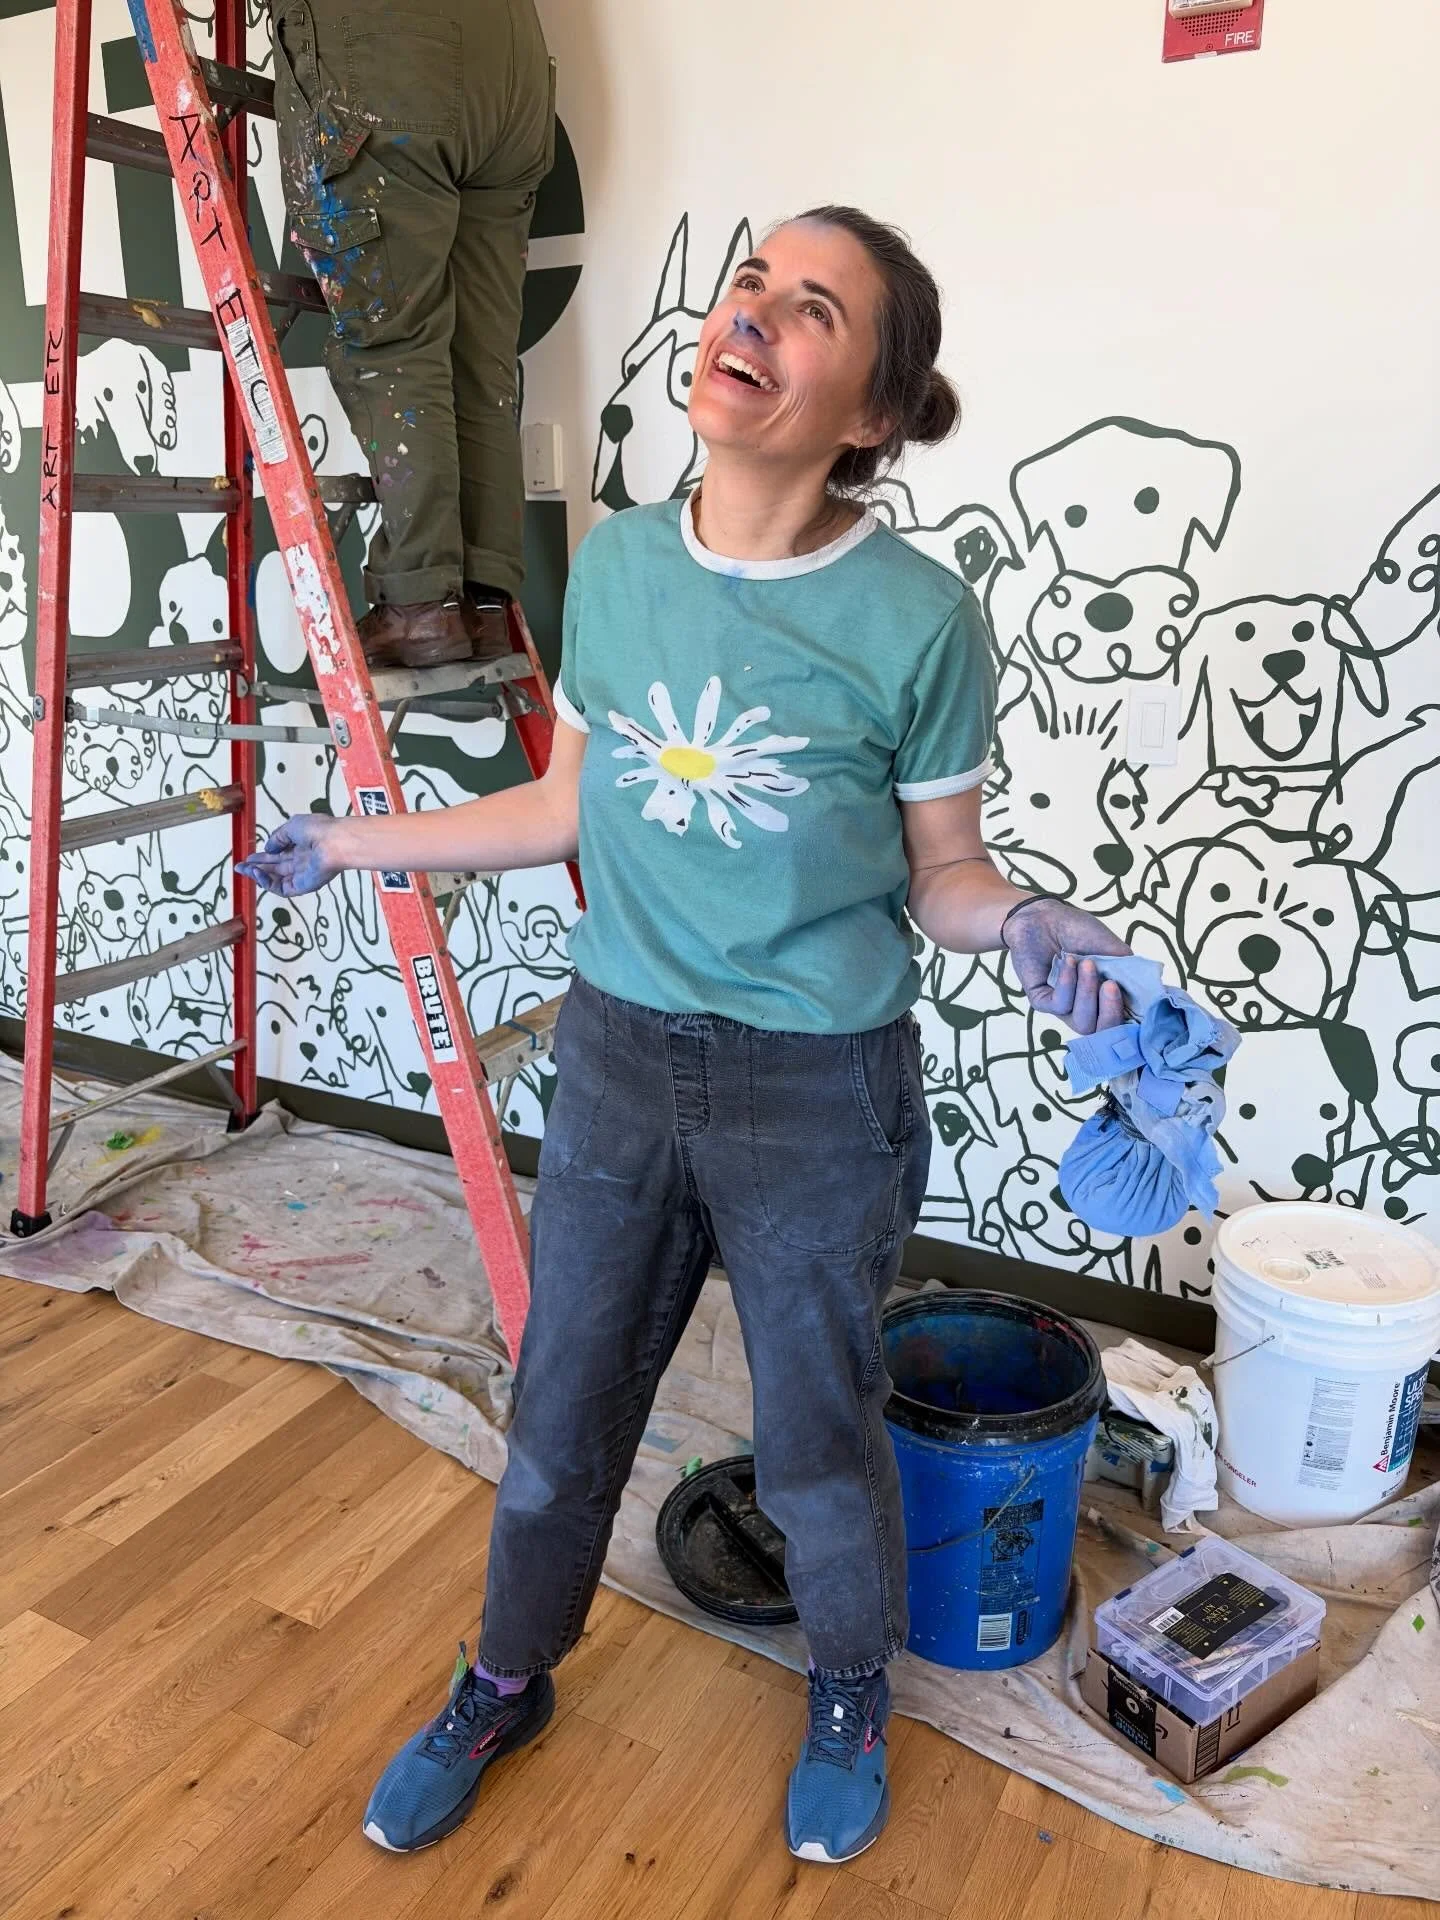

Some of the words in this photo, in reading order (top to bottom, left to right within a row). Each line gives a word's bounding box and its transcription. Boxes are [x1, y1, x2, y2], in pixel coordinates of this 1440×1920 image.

[1224, 30, 1255, 46] FIRE
[169, 113, 227, 252] ART
[215, 287, 269, 422] ETC
[45, 327, 63, 395] ETC
[42, 424, 58, 510] ART
[413, 957, 452, 1049] BRUTE
[1380, 1413, 1395, 1456] Benjamin
[1389, 1382, 1400, 1412] Moore
